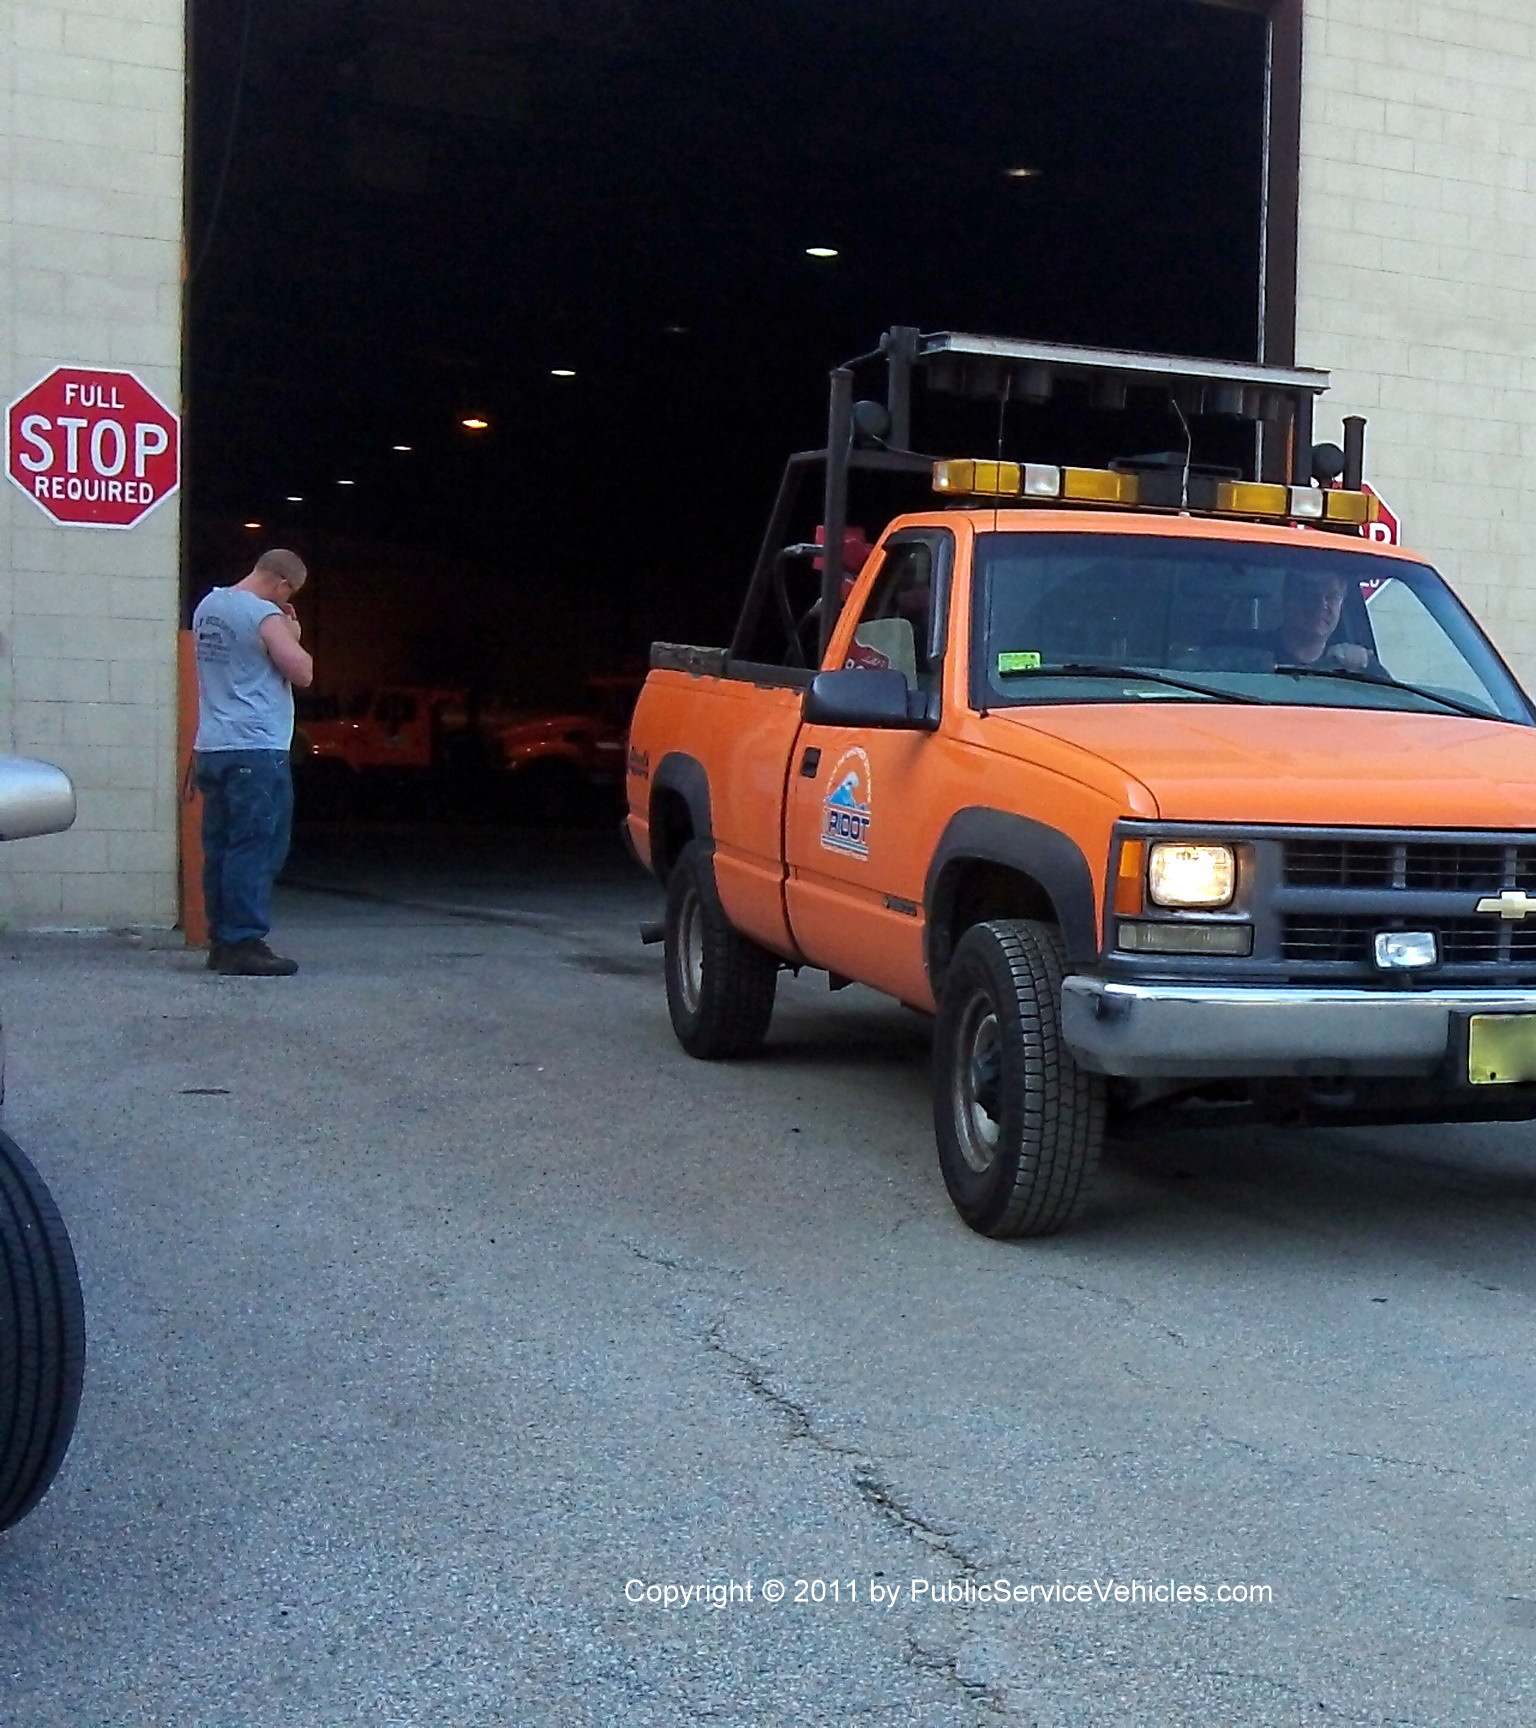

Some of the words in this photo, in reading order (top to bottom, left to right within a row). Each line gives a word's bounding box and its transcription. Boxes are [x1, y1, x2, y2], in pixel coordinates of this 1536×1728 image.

[65, 383, 125, 409] FULL
[19, 414, 169, 478] STOP
[35, 475, 154, 504] REQUIRED
